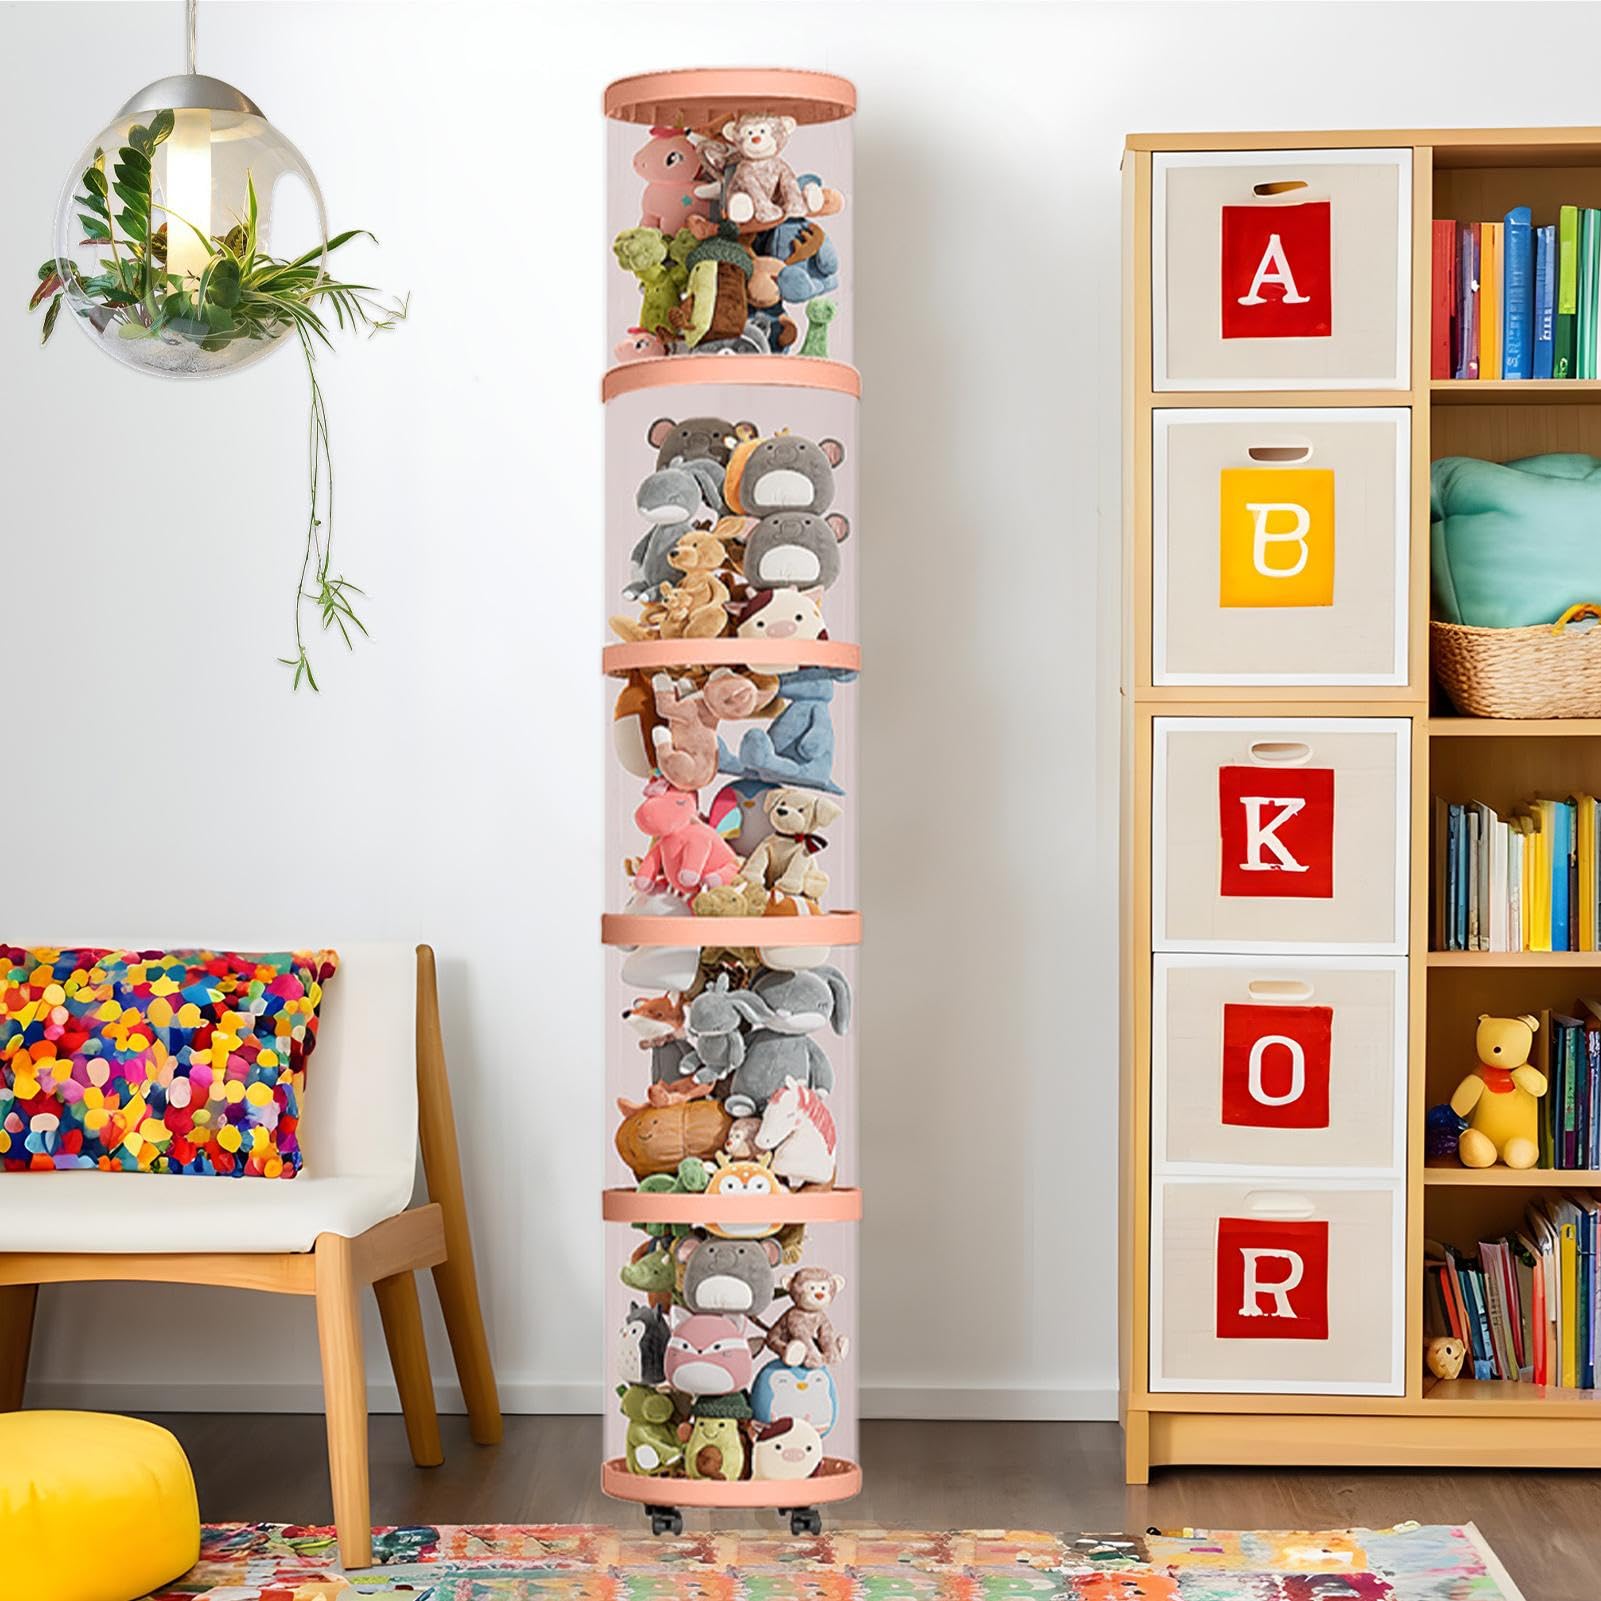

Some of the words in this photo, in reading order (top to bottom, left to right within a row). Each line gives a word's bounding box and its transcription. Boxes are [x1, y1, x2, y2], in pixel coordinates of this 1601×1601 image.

[1238, 234, 1310, 305] A
[1245, 502, 1310, 578] B
[1239, 796, 1309, 872] K
[1248, 1035, 1305, 1106] O
[1238, 1247, 1304, 1318] R
